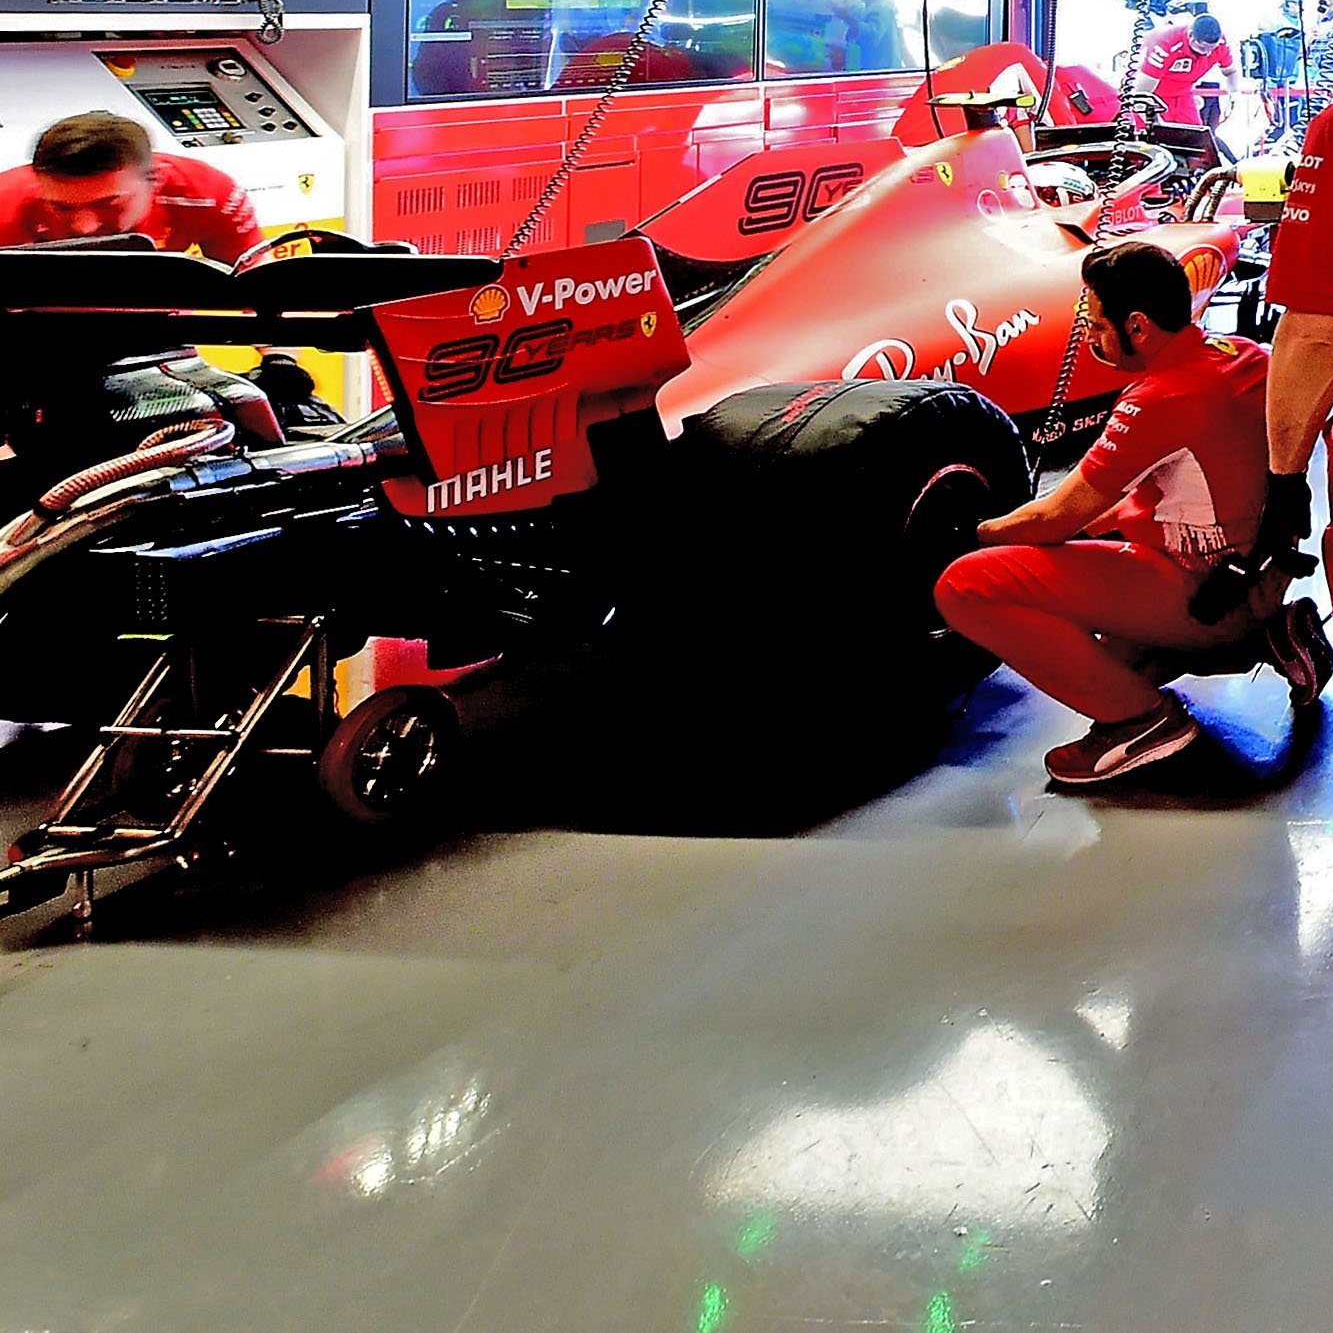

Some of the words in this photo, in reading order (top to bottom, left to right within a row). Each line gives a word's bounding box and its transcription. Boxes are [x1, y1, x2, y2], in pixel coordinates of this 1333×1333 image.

[1109, 206, 1140, 225] BLOT
[517, 268, 656, 317] V-Power
[524, 320, 638, 362] YEARS
[1073, 410, 1108, 432] SKF
[427, 448, 552, 514] MAHLE
